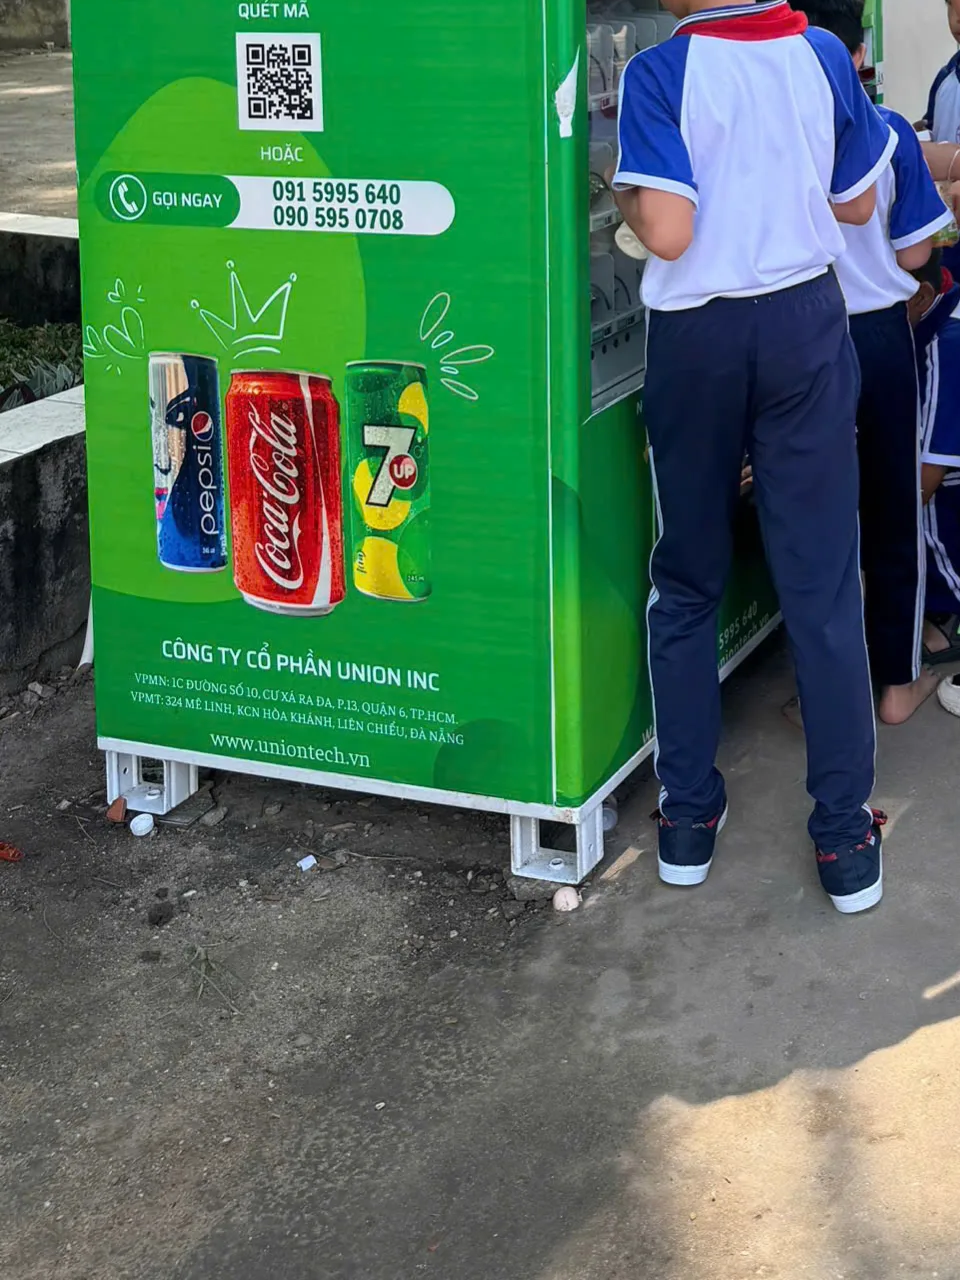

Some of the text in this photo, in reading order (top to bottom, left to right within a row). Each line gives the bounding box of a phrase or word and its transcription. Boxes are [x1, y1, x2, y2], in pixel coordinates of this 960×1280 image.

[238, 0, 309, 20] QUÉT MÃ
[260, 143, 304, 165] HOẶC
[152, 191, 222, 209] GỌI NGAY
[273, 180, 401, 205] 091 5995 640
[273, 205, 404, 230] 090 595 0708
[363, 424, 418, 508] 7 UP
[193, 445, 219, 535] pepsi
[162, 637, 440, 692] CÔNG TY CỔ PHẦN UNION INC
[134, 672, 170, 687] VPMN:
[186, 679, 227, 695] ĐƯỜNG
[229, 682, 244, 696] SỐ
[299, 693, 314, 706] RA
[130, 691, 164, 705] VPMT:
[165, 695, 182, 707] 324
[185, 698, 202, 710] MÊ
[204, 700, 235, 715] LINH,
[237, 705, 260, 718] KCN
[338, 718, 364, 732] LIÊN
[410, 727, 427, 740] ĐÀ
[210, 733, 371, 768] www.uniontech.vn
